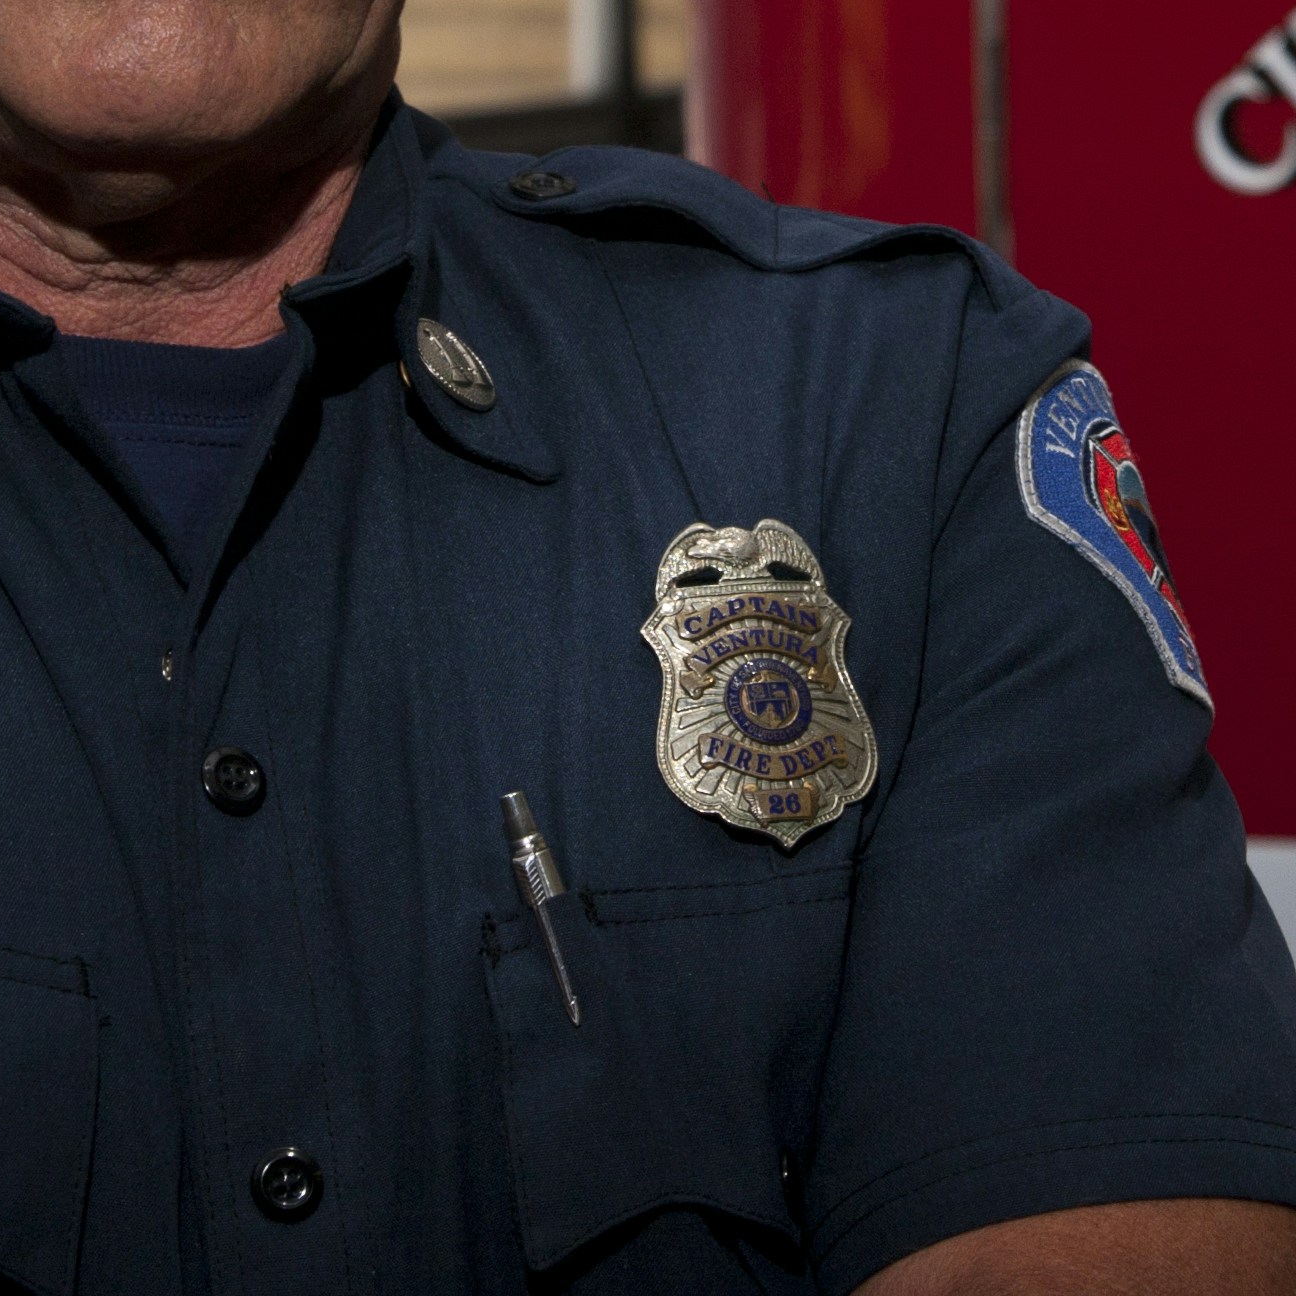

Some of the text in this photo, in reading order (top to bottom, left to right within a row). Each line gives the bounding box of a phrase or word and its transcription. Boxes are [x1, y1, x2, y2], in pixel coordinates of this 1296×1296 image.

[684, 597, 818, 634] CAPTAIN
[693, 629, 819, 665] VENTURA
[706, 736, 770, 775] FIRE
[768, 793, 801, 814] 26
